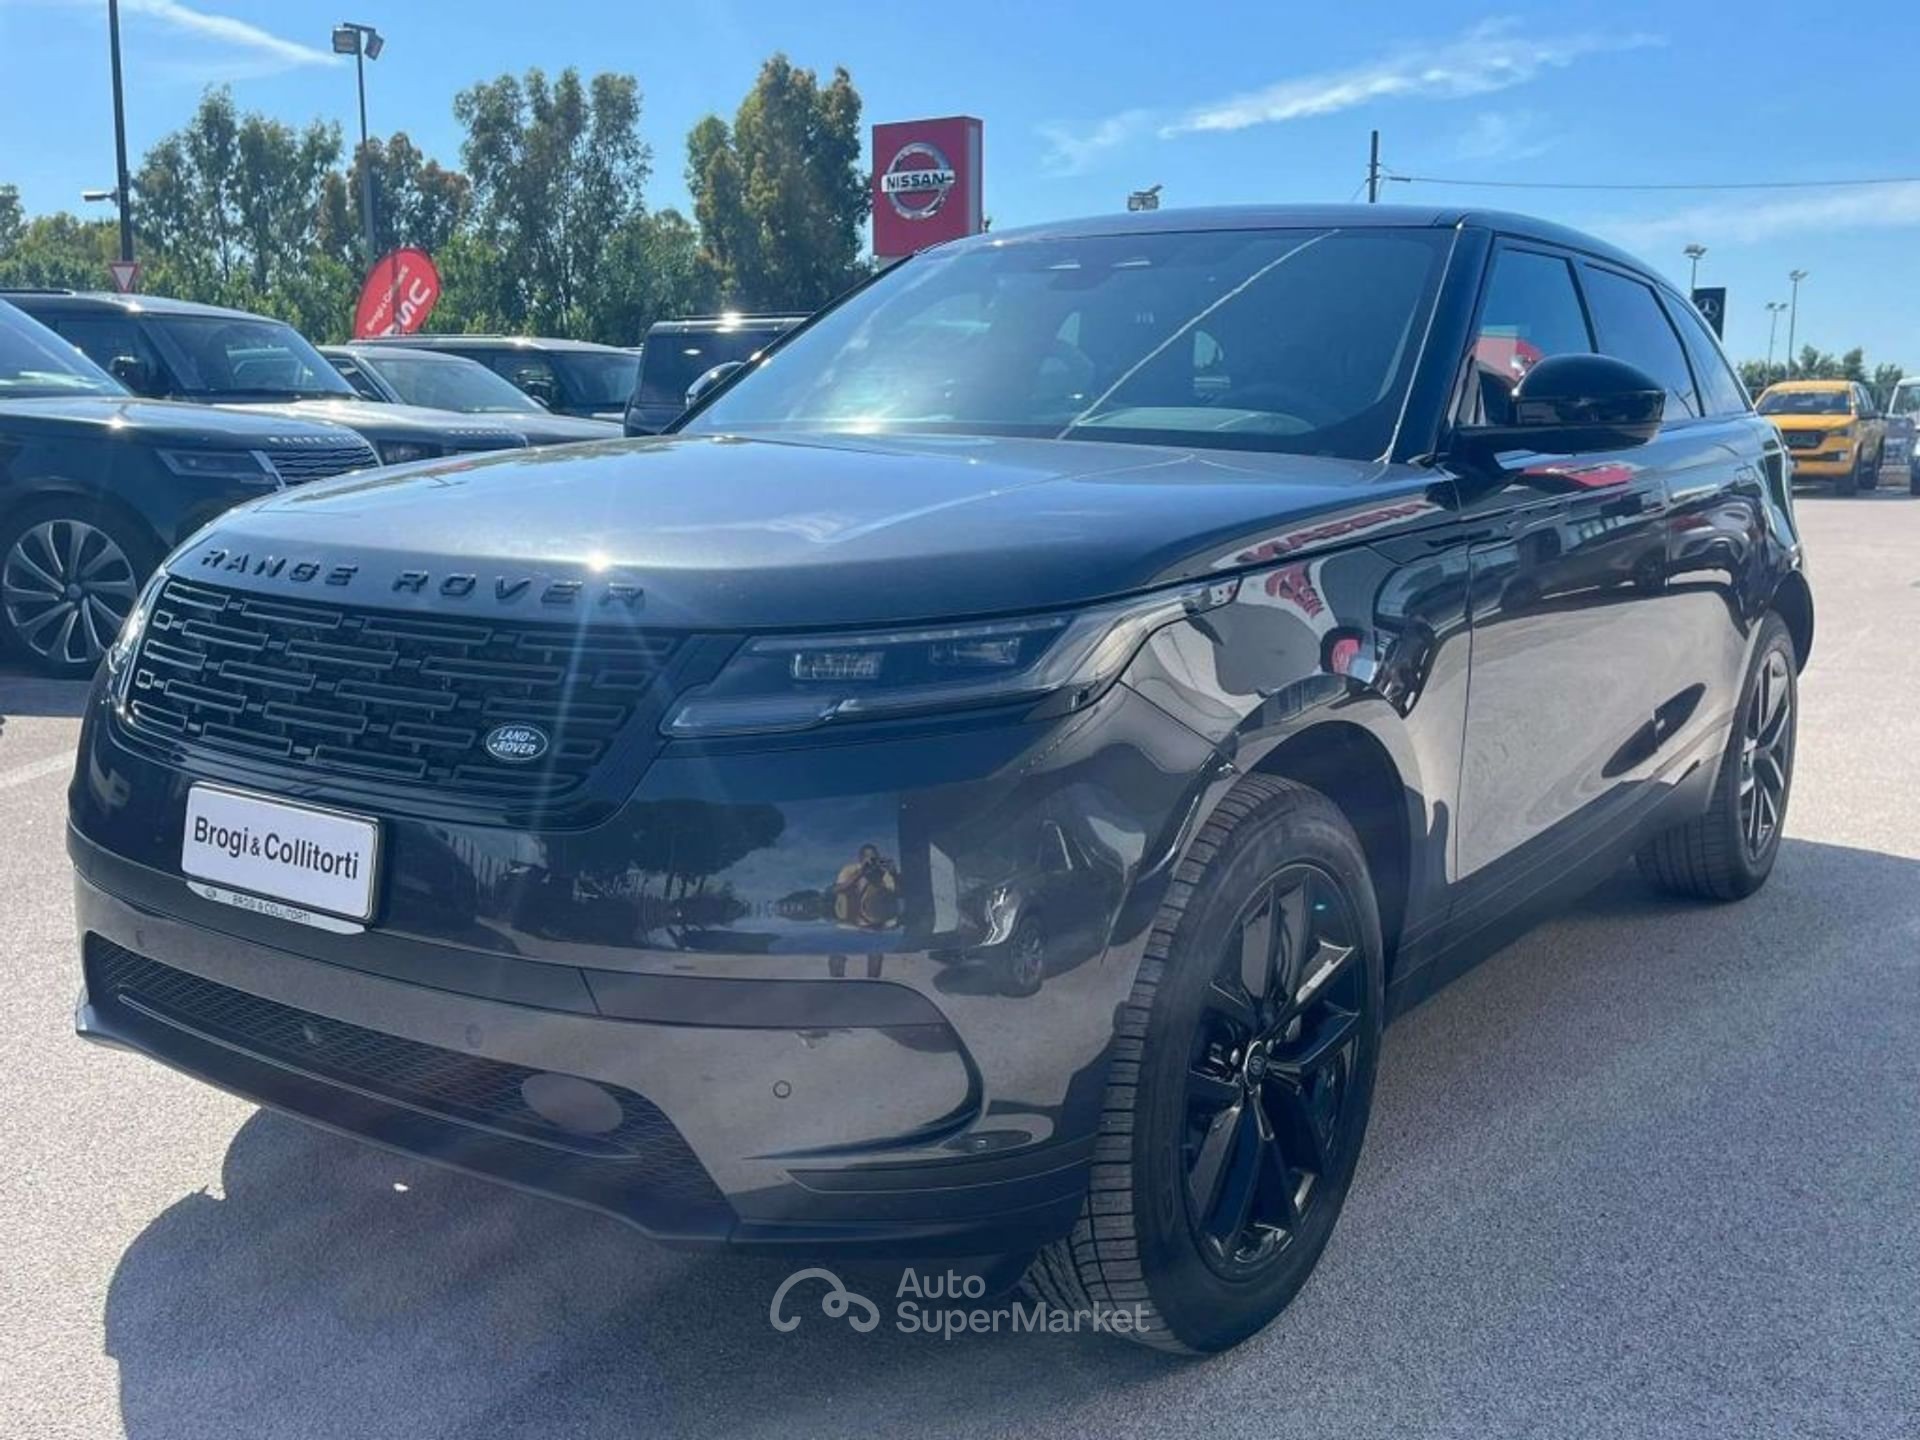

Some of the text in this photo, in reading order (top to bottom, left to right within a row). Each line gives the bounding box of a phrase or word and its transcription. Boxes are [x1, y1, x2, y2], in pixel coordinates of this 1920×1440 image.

[886, 173, 945, 188] NISSAN
[201, 549, 645, 607] RANGE ROVER
